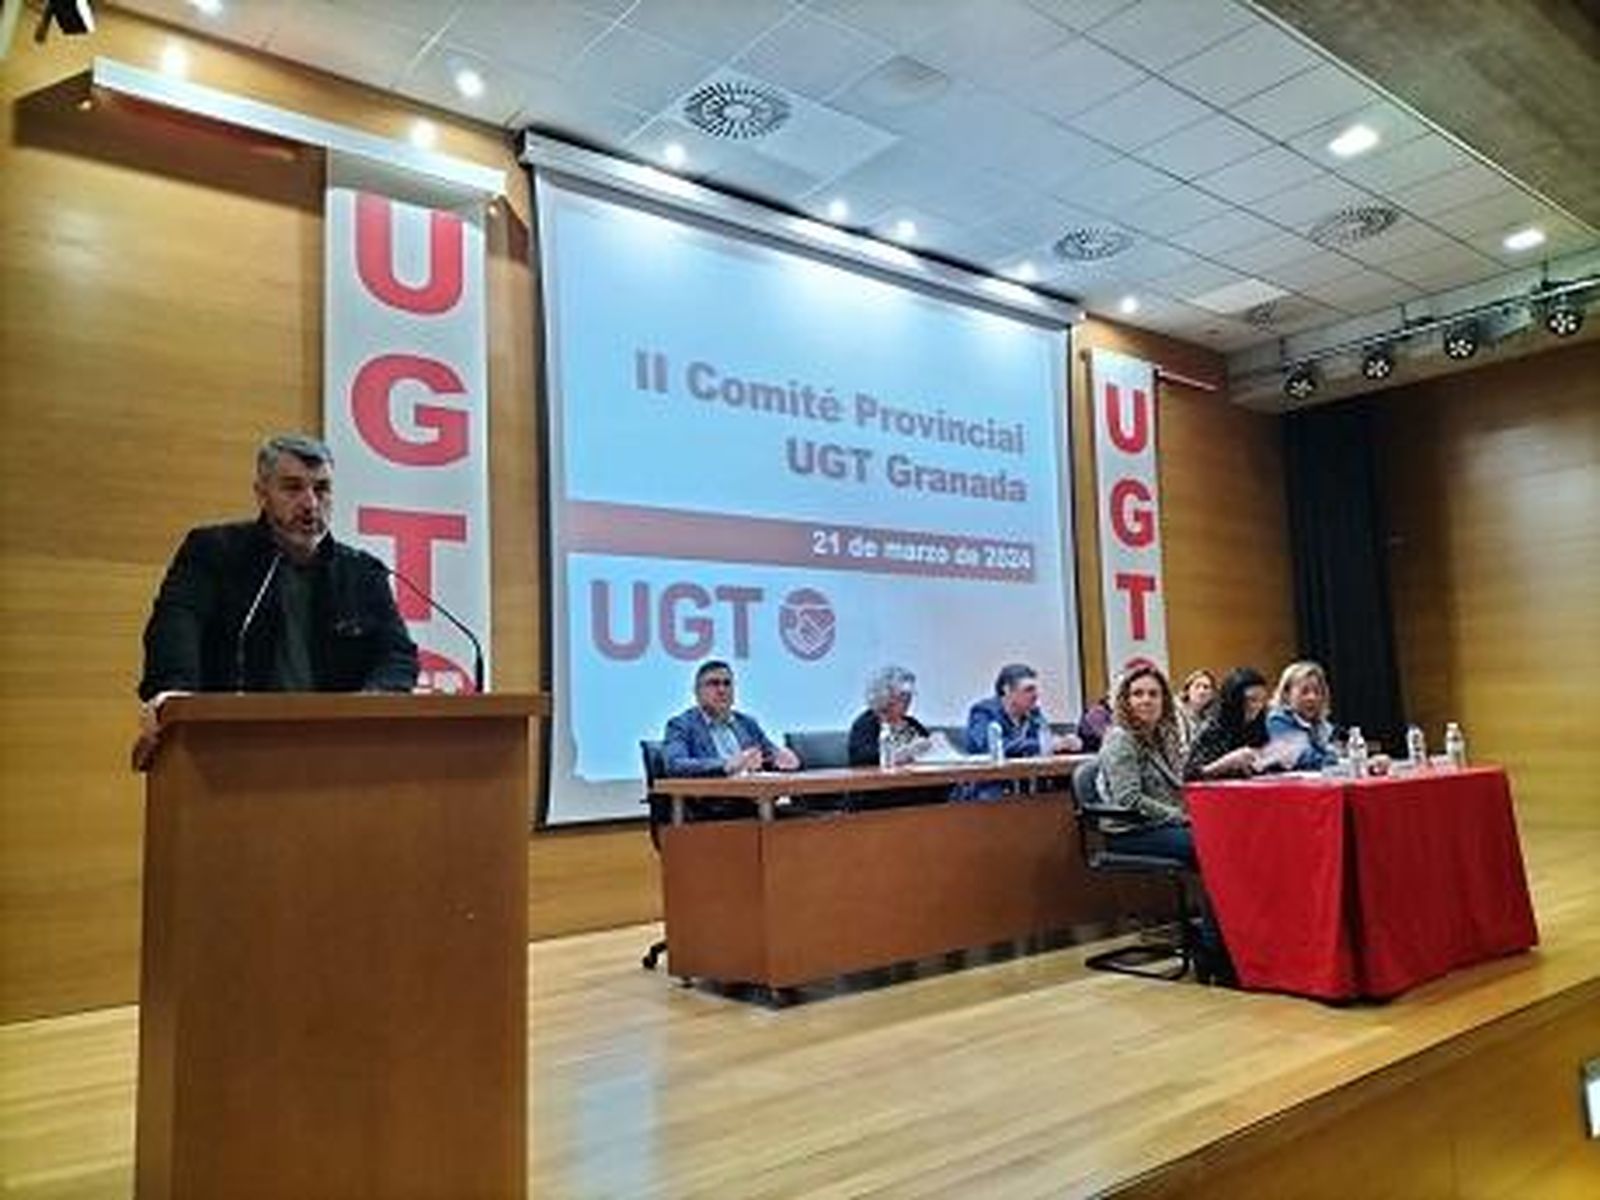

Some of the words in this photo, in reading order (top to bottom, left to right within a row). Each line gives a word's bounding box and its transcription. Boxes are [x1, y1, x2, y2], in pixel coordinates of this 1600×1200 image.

[351, 189, 470, 622] UGT
[634, 347, 669, 393] II
[686, 361, 842, 422] Comité
[855, 392, 1024, 455] Provincial
[785, 436, 873, 483] UGT
[886, 453, 1027, 502] Granada
[1105, 383, 1156, 641] UGT
[811, 530, 840, 555] 21
[848, 536, 877, 558] de
[883, 541, 950, 564] marzo
[955, 545, 979, 565] de
[984, 545, 1031, 569] 2024
[590, 579, 764, 662] UGT
